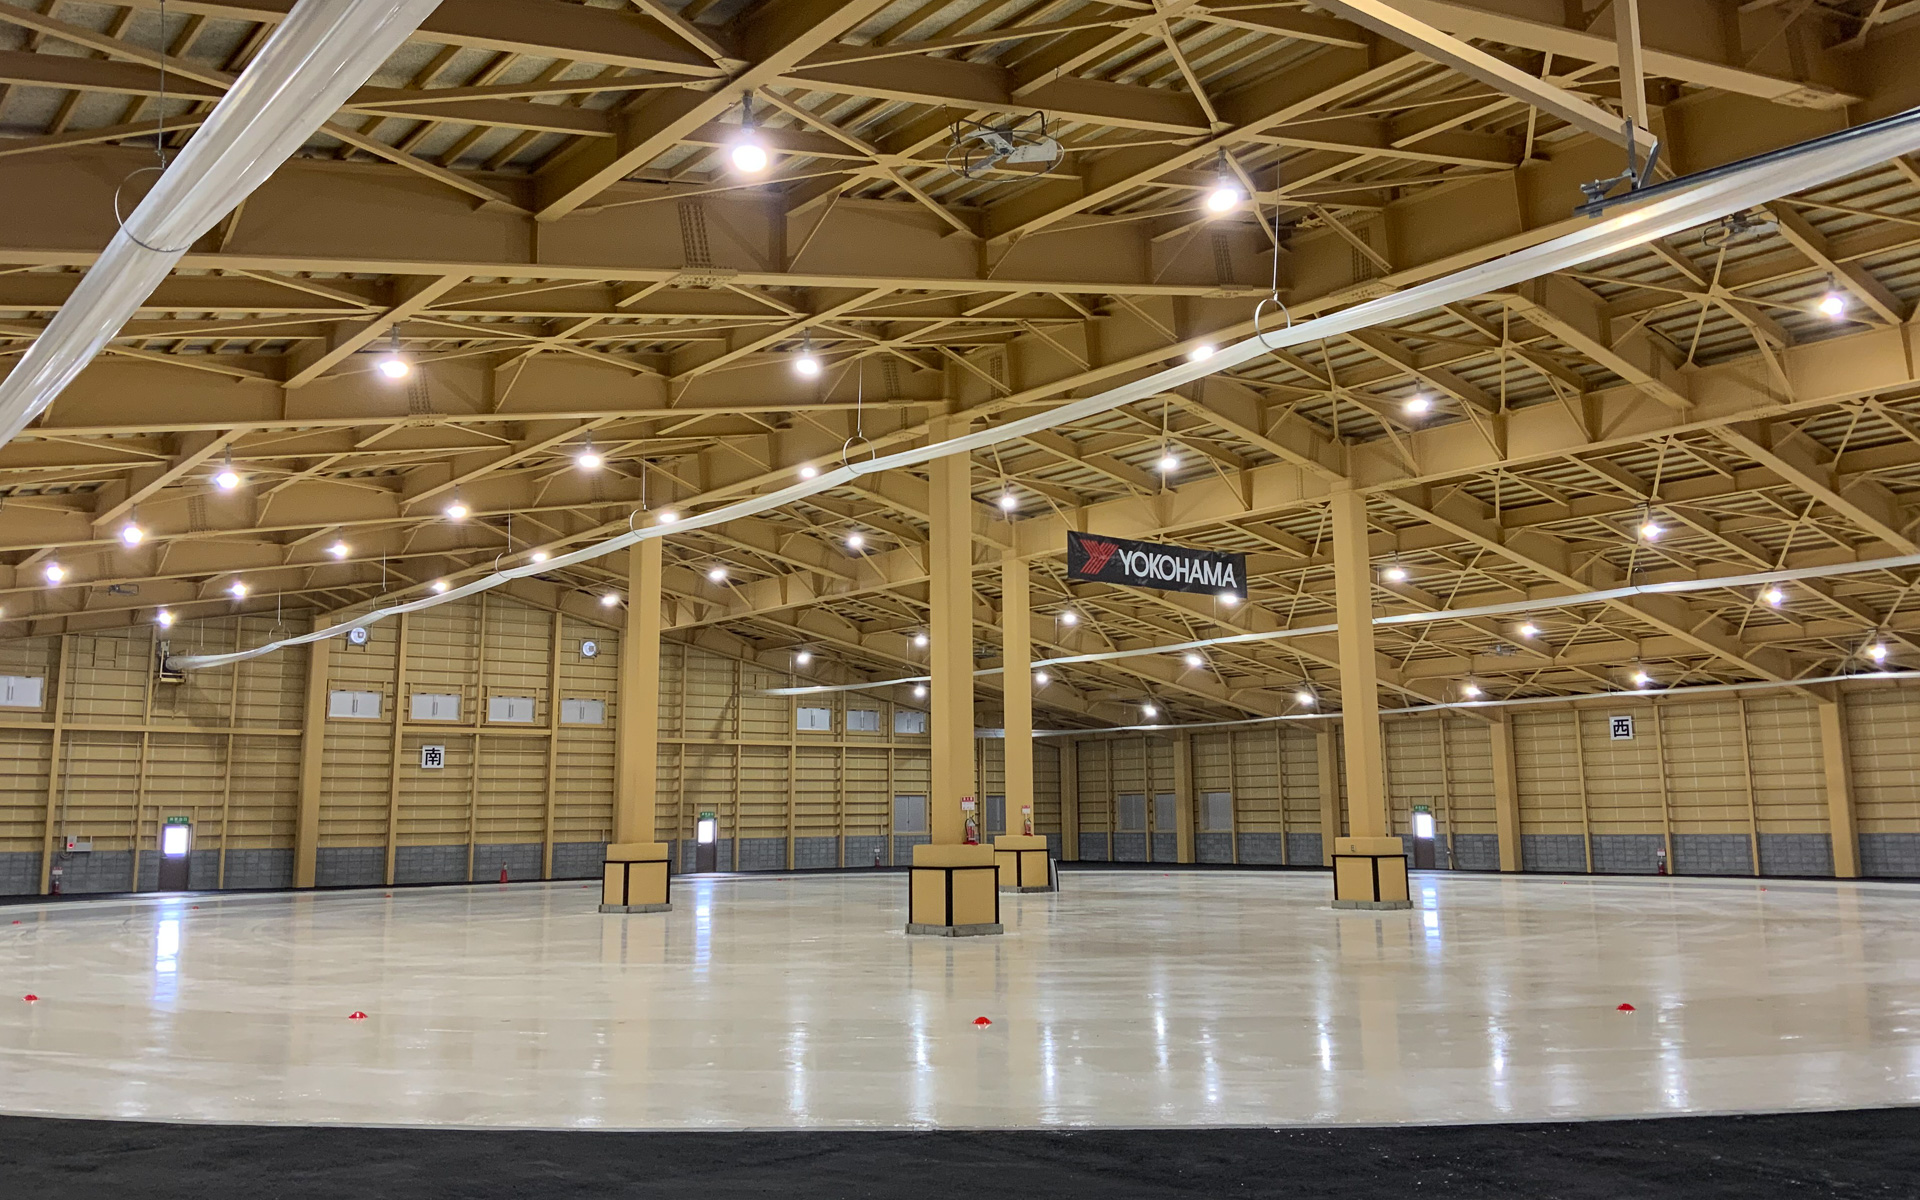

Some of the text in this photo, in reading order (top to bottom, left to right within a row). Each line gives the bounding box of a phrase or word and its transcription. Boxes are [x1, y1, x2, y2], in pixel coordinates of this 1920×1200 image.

[1118, 548, 1238, 588] YOKOHAMA
[1613, 718, 1630, 737] 西
[424, 747, 442, 766] 南
